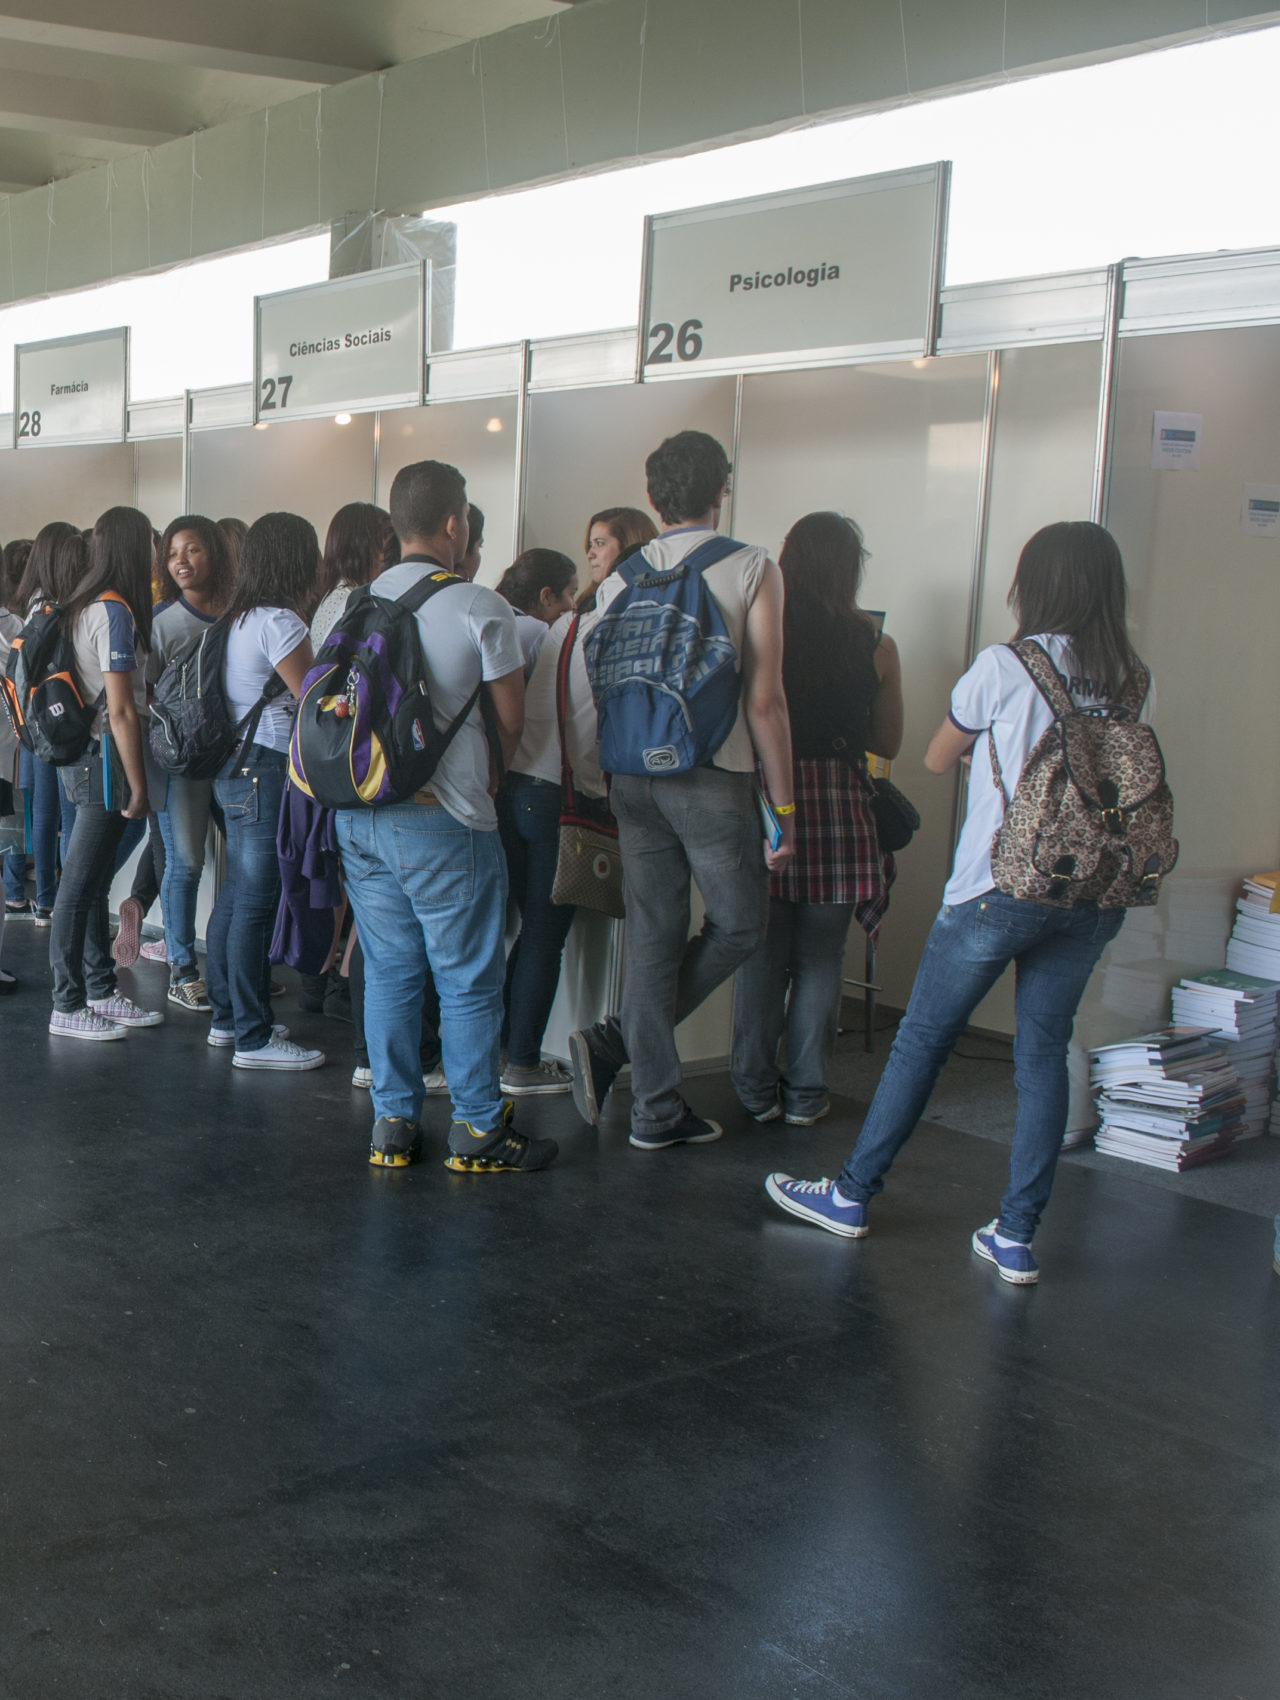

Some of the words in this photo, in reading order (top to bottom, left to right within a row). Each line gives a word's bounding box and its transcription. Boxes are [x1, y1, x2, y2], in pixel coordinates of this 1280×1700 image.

[729, 262, 840, 293] Psicologia
[289, 337, 341, 358] Ciências
[344, 328, 392, 348] Sociais
[647, 318, 704, 365] 26
[50, 380, 89, 396] Farmácia
[261, 375, 293, 410] 27
[19, 410, 41, 437] 28
